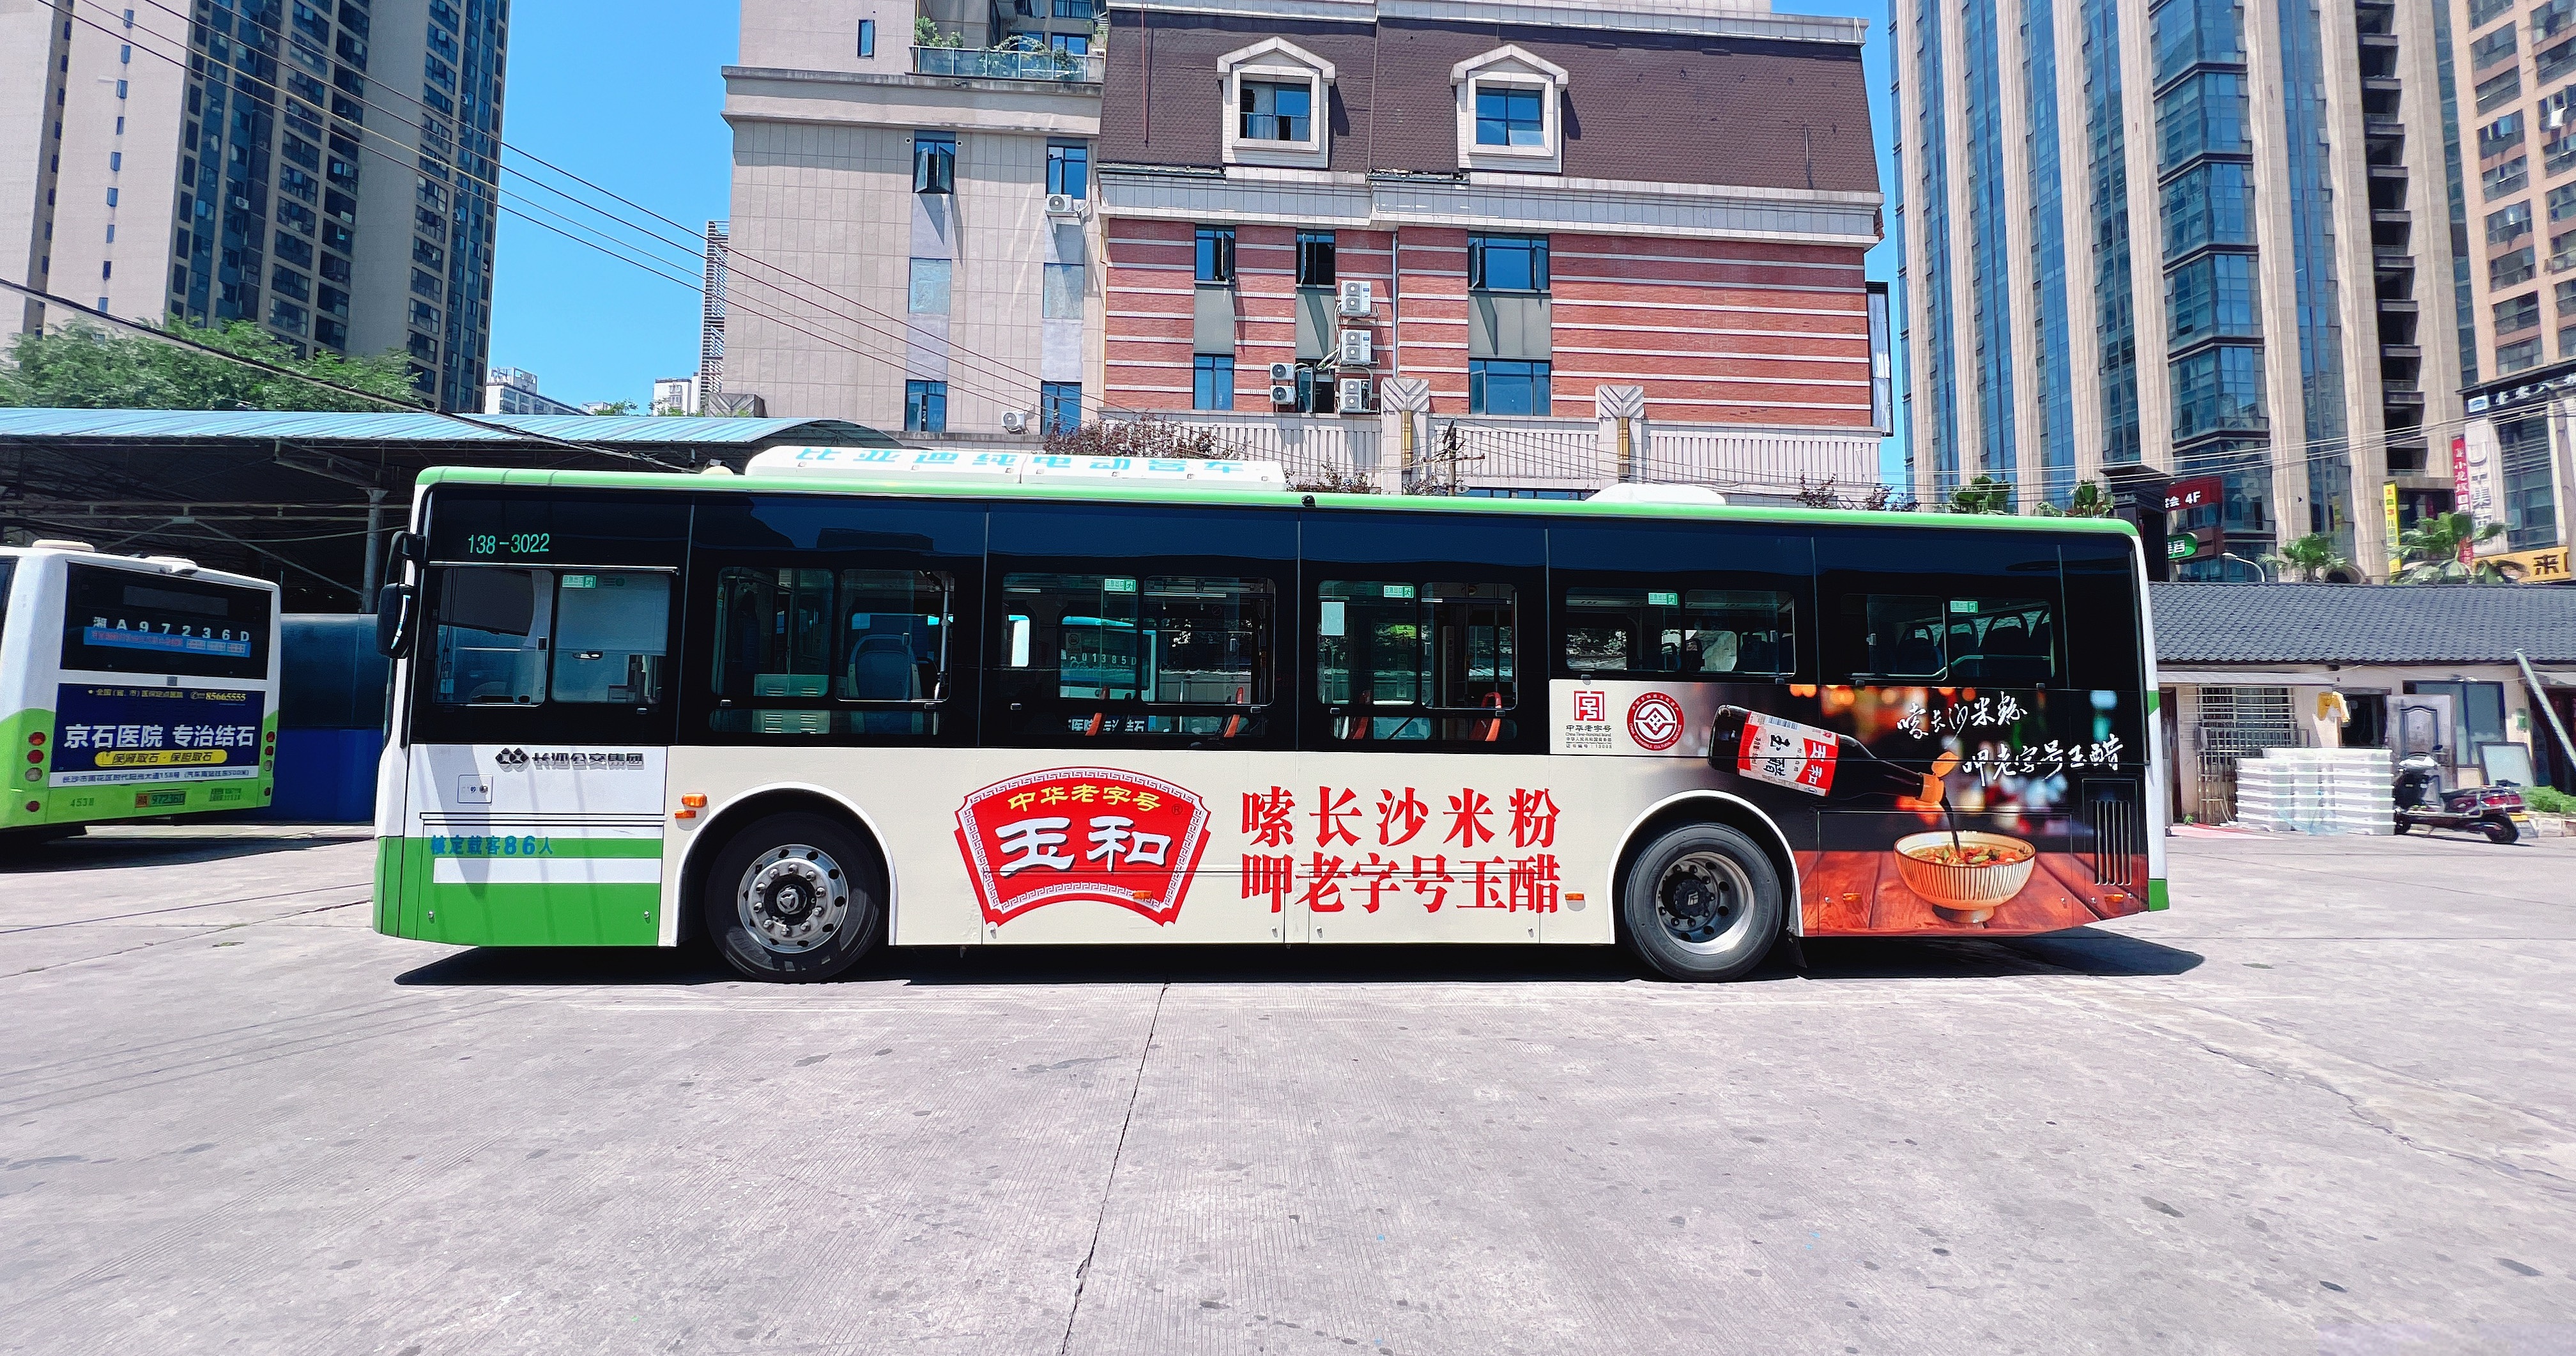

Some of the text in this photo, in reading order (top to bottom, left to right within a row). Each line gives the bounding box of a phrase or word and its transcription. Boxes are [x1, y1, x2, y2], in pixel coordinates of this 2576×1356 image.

[2185, 491, 2201, 504] 4F
[468, 533, 549, 555] 138-3022
[65, 723, 256, 749] 京石医院 专治结石
[1008, 785, 1162, 813] 中华老字号
[1241, 785, 1561, 849] 嗦长沙米粉
[430, 834, 553, 856] 核定载客86人
[999, 815, 1172, 877] 玉和
[1241, 851, 1561, 914] 呷老字号玉醋
